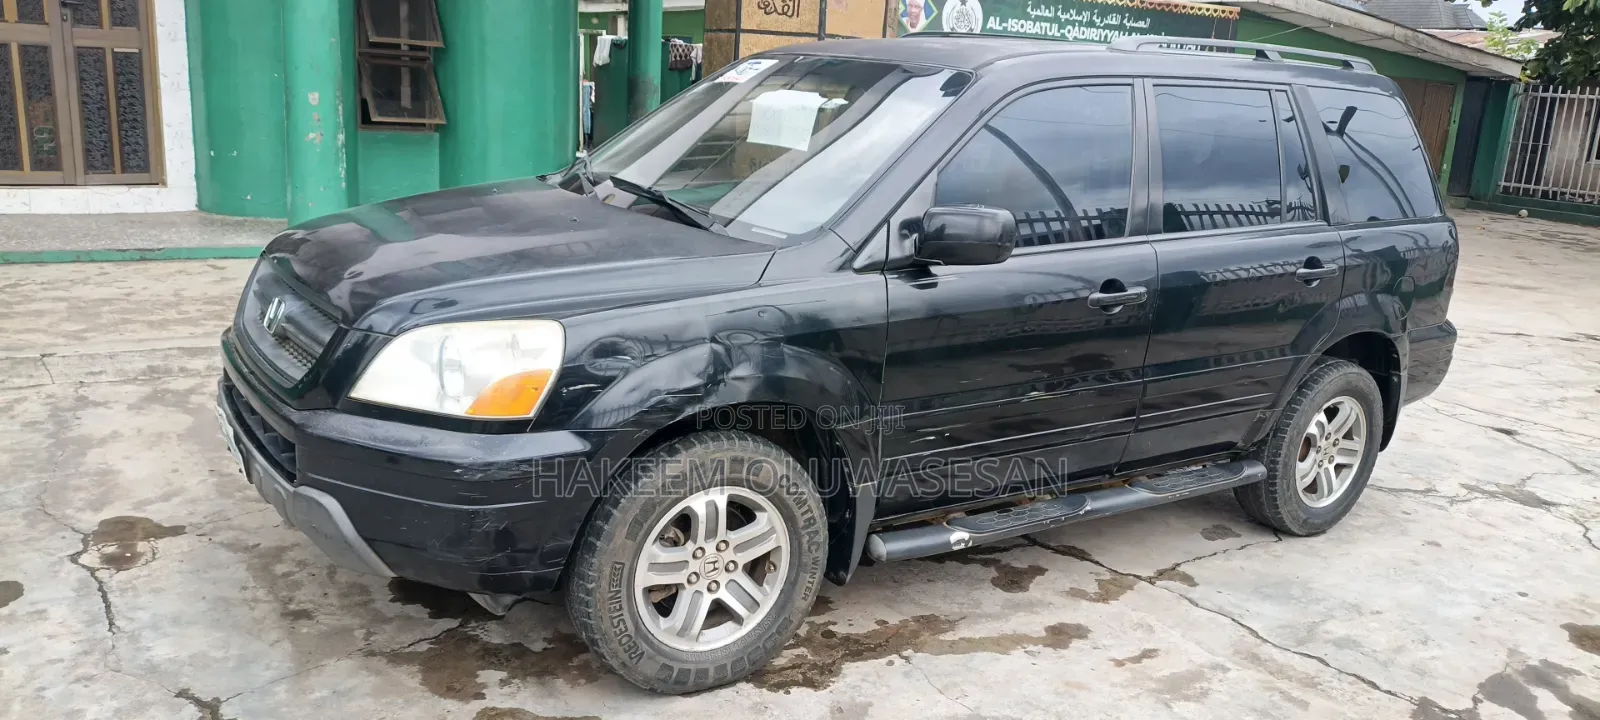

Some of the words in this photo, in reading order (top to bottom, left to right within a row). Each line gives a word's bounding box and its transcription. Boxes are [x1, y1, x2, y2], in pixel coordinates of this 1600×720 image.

[779, 473, 821, 555] COMTRAC
[801, 555, 820, 602] WINTER
[607, 587, 646, 665] VREDESTEIN
